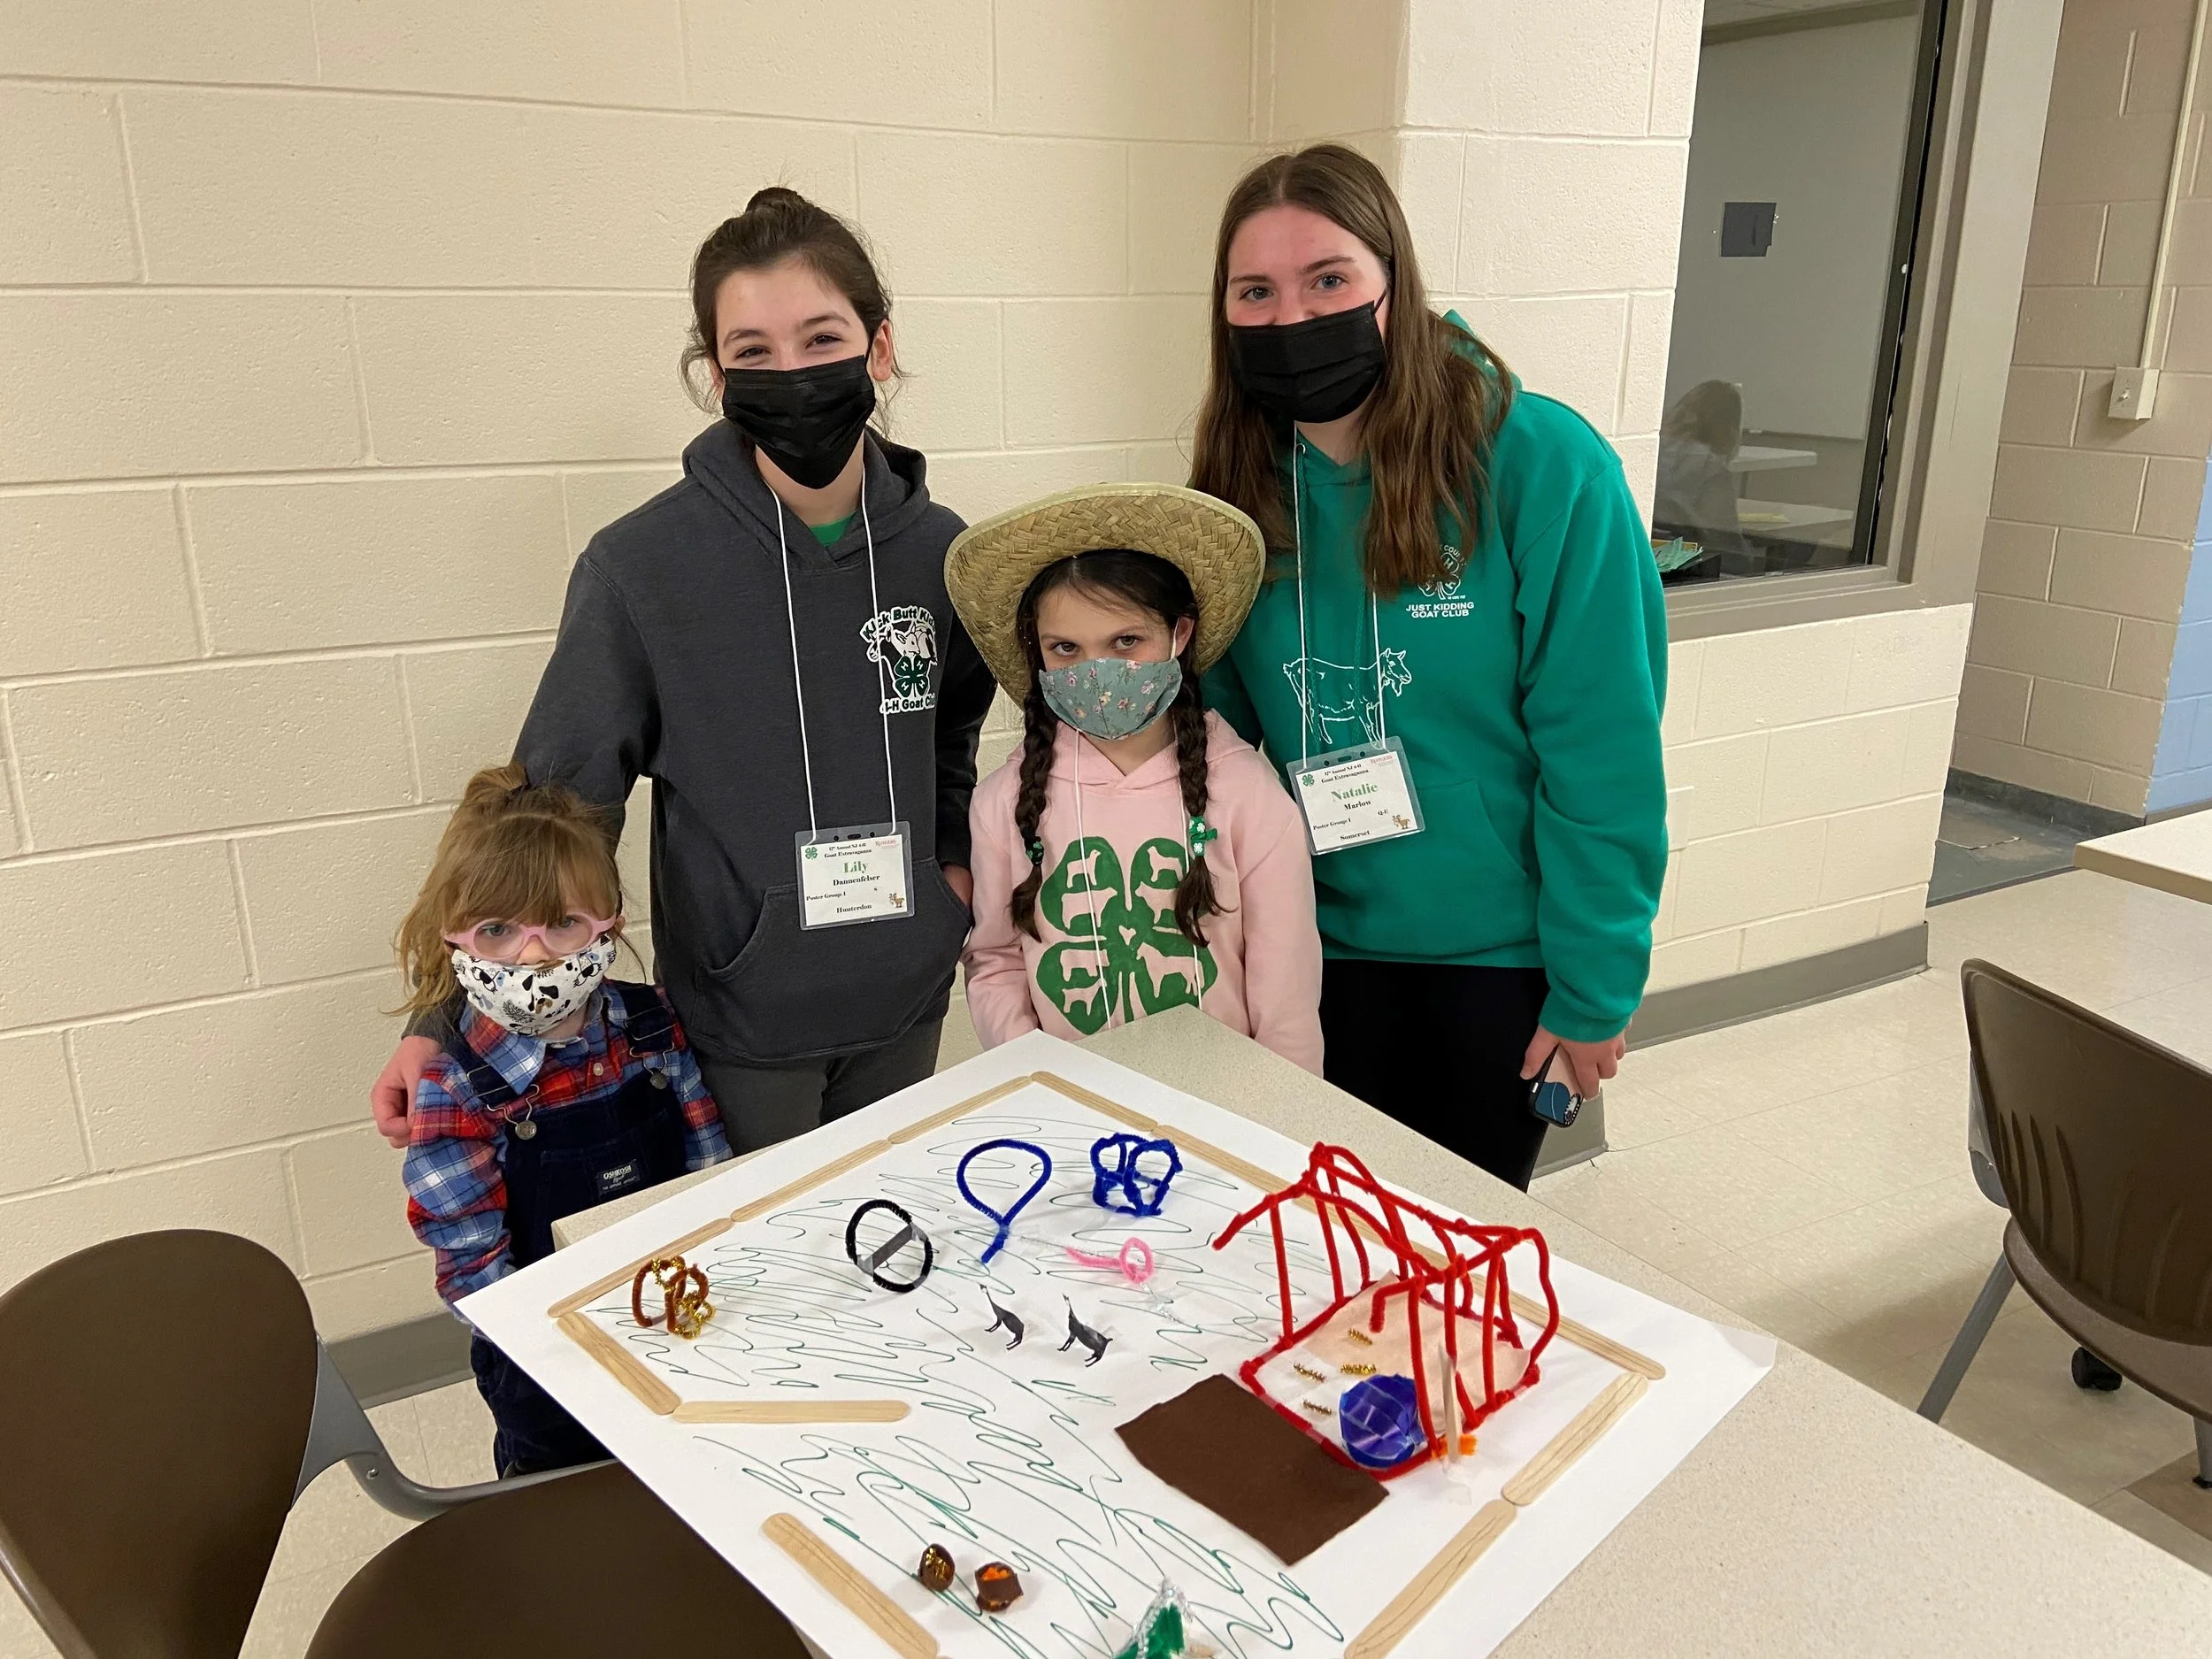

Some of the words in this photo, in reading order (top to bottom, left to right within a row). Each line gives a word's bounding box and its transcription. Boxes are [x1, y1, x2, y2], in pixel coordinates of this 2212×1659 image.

[1433, 602, 1474, 611] KIDDING
[893, 609, 917, 620] Butt
[902, 697, 923, 710] Goat
[1331, 783, 1378, 802] Natalie
[1344, 799, 1371, 810] Marlow
[1340, 830, 1371, 840] Somerset
[843, 861, 868, 874] Lily
[833, 874, 880, 886] Dannenfelser
[836, 903, 872, 913] Hunterdon
